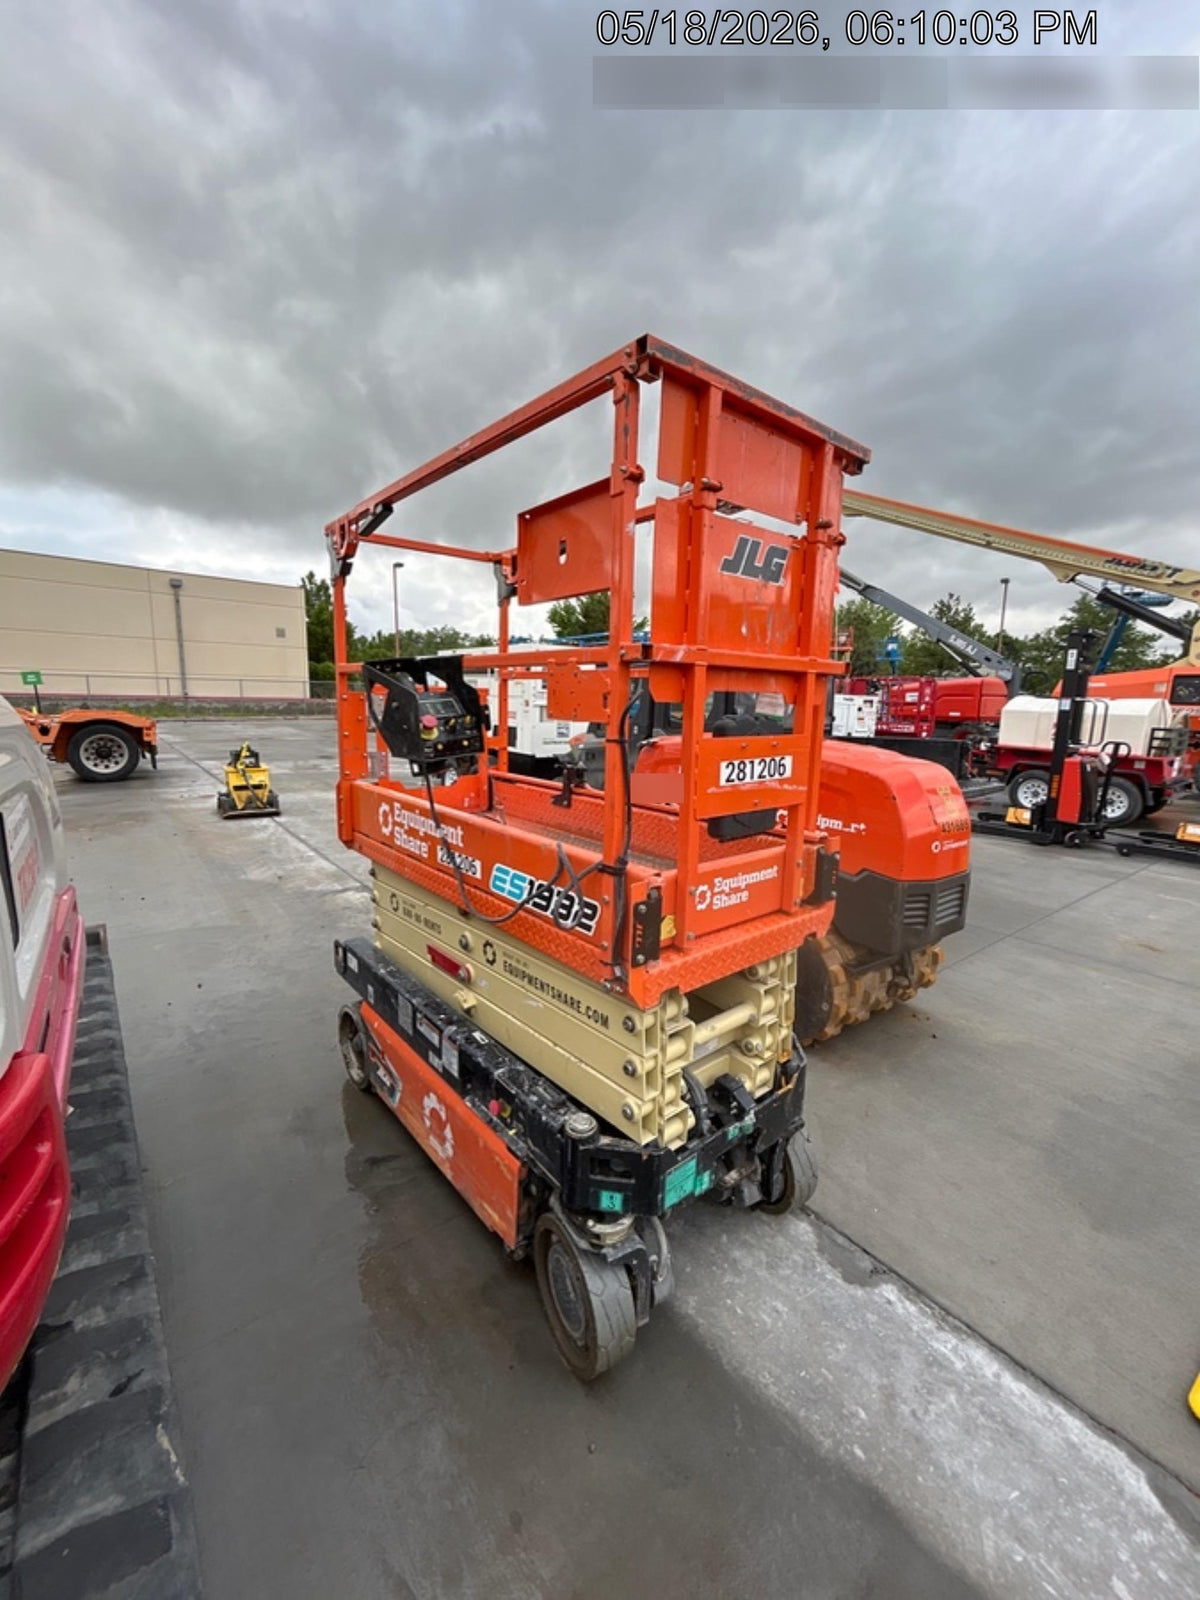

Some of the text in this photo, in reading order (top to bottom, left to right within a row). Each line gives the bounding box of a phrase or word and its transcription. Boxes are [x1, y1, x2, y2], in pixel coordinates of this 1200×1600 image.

[719, 534, 789, 585] JLG
[725, 757, 786, 783] 281206
[394, 825, 428, 858] Share
[439, 846, 478, 876] 28206
[713, 864, 778, 893] Equipment
[712, 890, 749, 910] Share
[503, 960, 609, 1029] EQUIPMENTSHARE.COM
